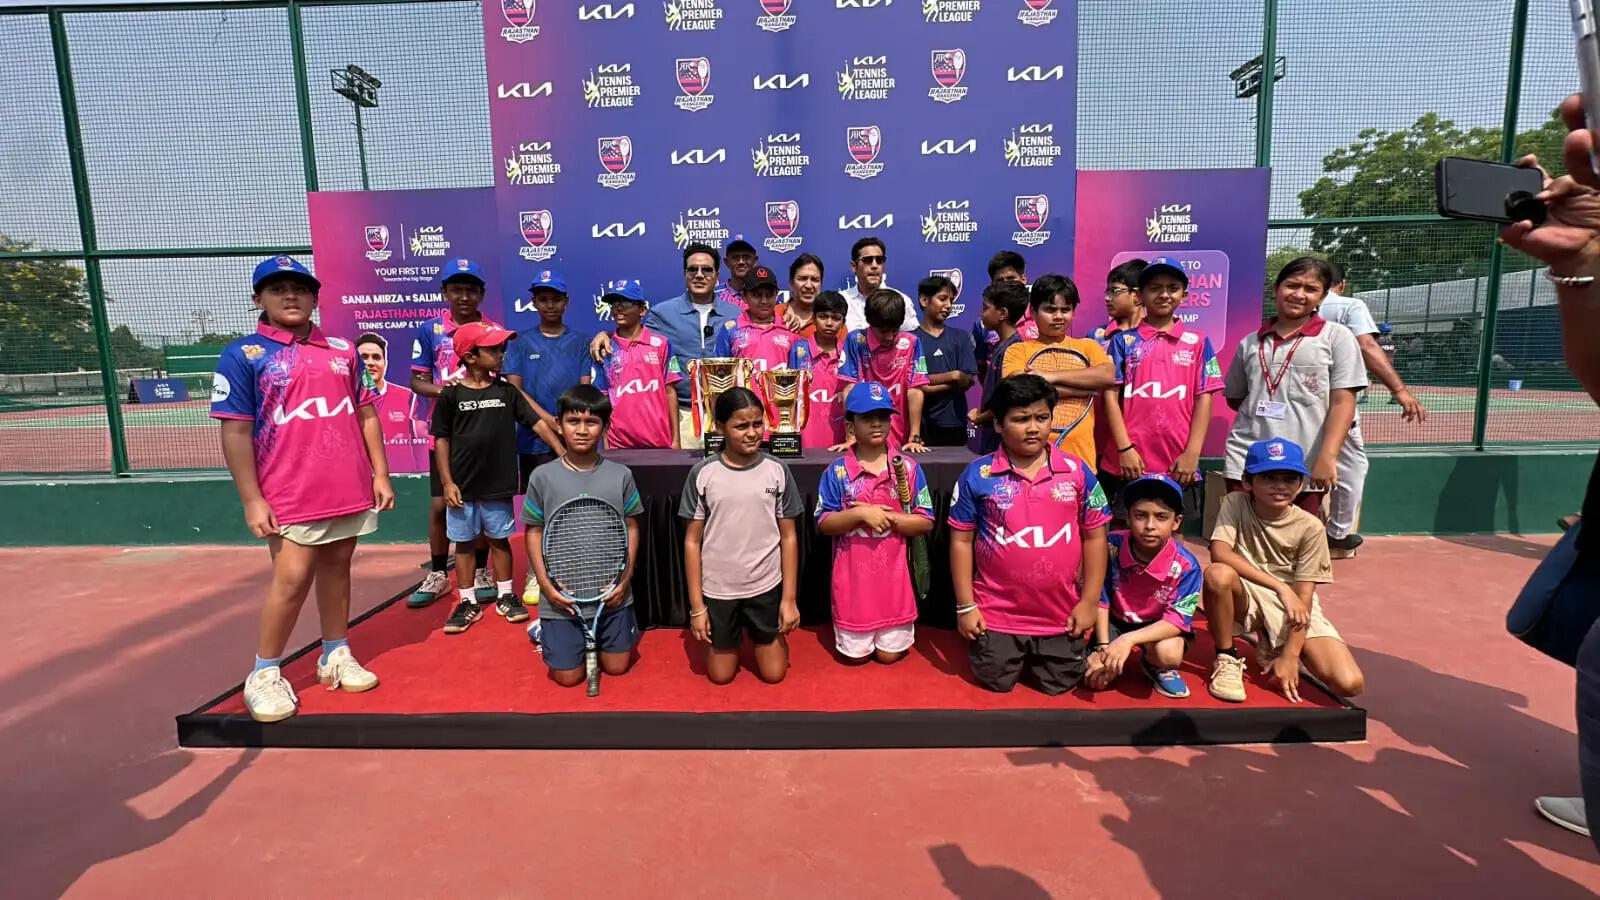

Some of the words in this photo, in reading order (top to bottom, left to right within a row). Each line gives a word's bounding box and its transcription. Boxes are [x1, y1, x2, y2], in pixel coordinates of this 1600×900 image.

[682, 0, 714, 8] TENNIS
[940, 0, 980, 10] PREMIER
[578, 4, 635, 20] KIA
[682, 9, 722, 19] PREMIER
[940, 12, 972, 22] LEAGUE
[682, 20, 716, 30] LEAGUE
[855, 69, 886, 78] TENNIS
[1008, 66, 1063, 81] KIA
[600, 76, 632, 86] TENNIS
[753, 74, 808, 90] KIA
[855, 78, 895, 89] PREMIER
[498, 82, 552, 98] KIA
[600, 86, 640, 96] PREMIER
[855, 90, 888, 99] LEAGUE
[601, 97, 633, 107] LEAGUE
[1022, 136, 1052, 146] TENNIS
[768, 146, 800, 156] TENNIS
[922, 139, 976, 154] KIA
[1022, 146, 1060, 156] PREMIER
[521, 154, 552, 164] TENNIS
[671, 149, 725, 164] KIA
[770, 156, 809, 166] PREMIER
[1021, 156, 1054, 166] LEAGUE
[522, 164, 560, 174] PREMIER
[770, 166, 802, 176] LEAGUE
[522, 174, 554, 184] LEAGUE
[838, 214, 894, 229] KIA
[938, 212, 969, 222] TENNIS
[1162, 215, 1191, 224] TENNIS
[688, 220, 720, 229] TENNIS
[938, 222, 978, 232] PREMIER
[1162, 224, 1198, 233] PREMIER
[592, 222, 646, 238] KIA
[690, 229, 728, 240] PREMIER
[938, 232, 970, 242] LEAGUE
[1160, 234, 1191, 242] LEAGUE
[1187, 260, 1201, 270] TO
[375, 268, 398, 276] YOUR
[399, 267, 418, 276] FIRST
[421, 266, 440, 274] STEP
[342, 295, 372, 304] SANIA
[374, 294, 404, 304] MIRZA
[412, 293, 442, 302] SALIM
[354, 309, 416, 320] RAJASTHAN
[420, 308, 449, 318] RANG
[616, 380, 659, 398] KIA
[1124, 381, 1187, 400] KIA
[274, 396, 355, 424] KIA
[995, 523, 1071, 548] KIA
